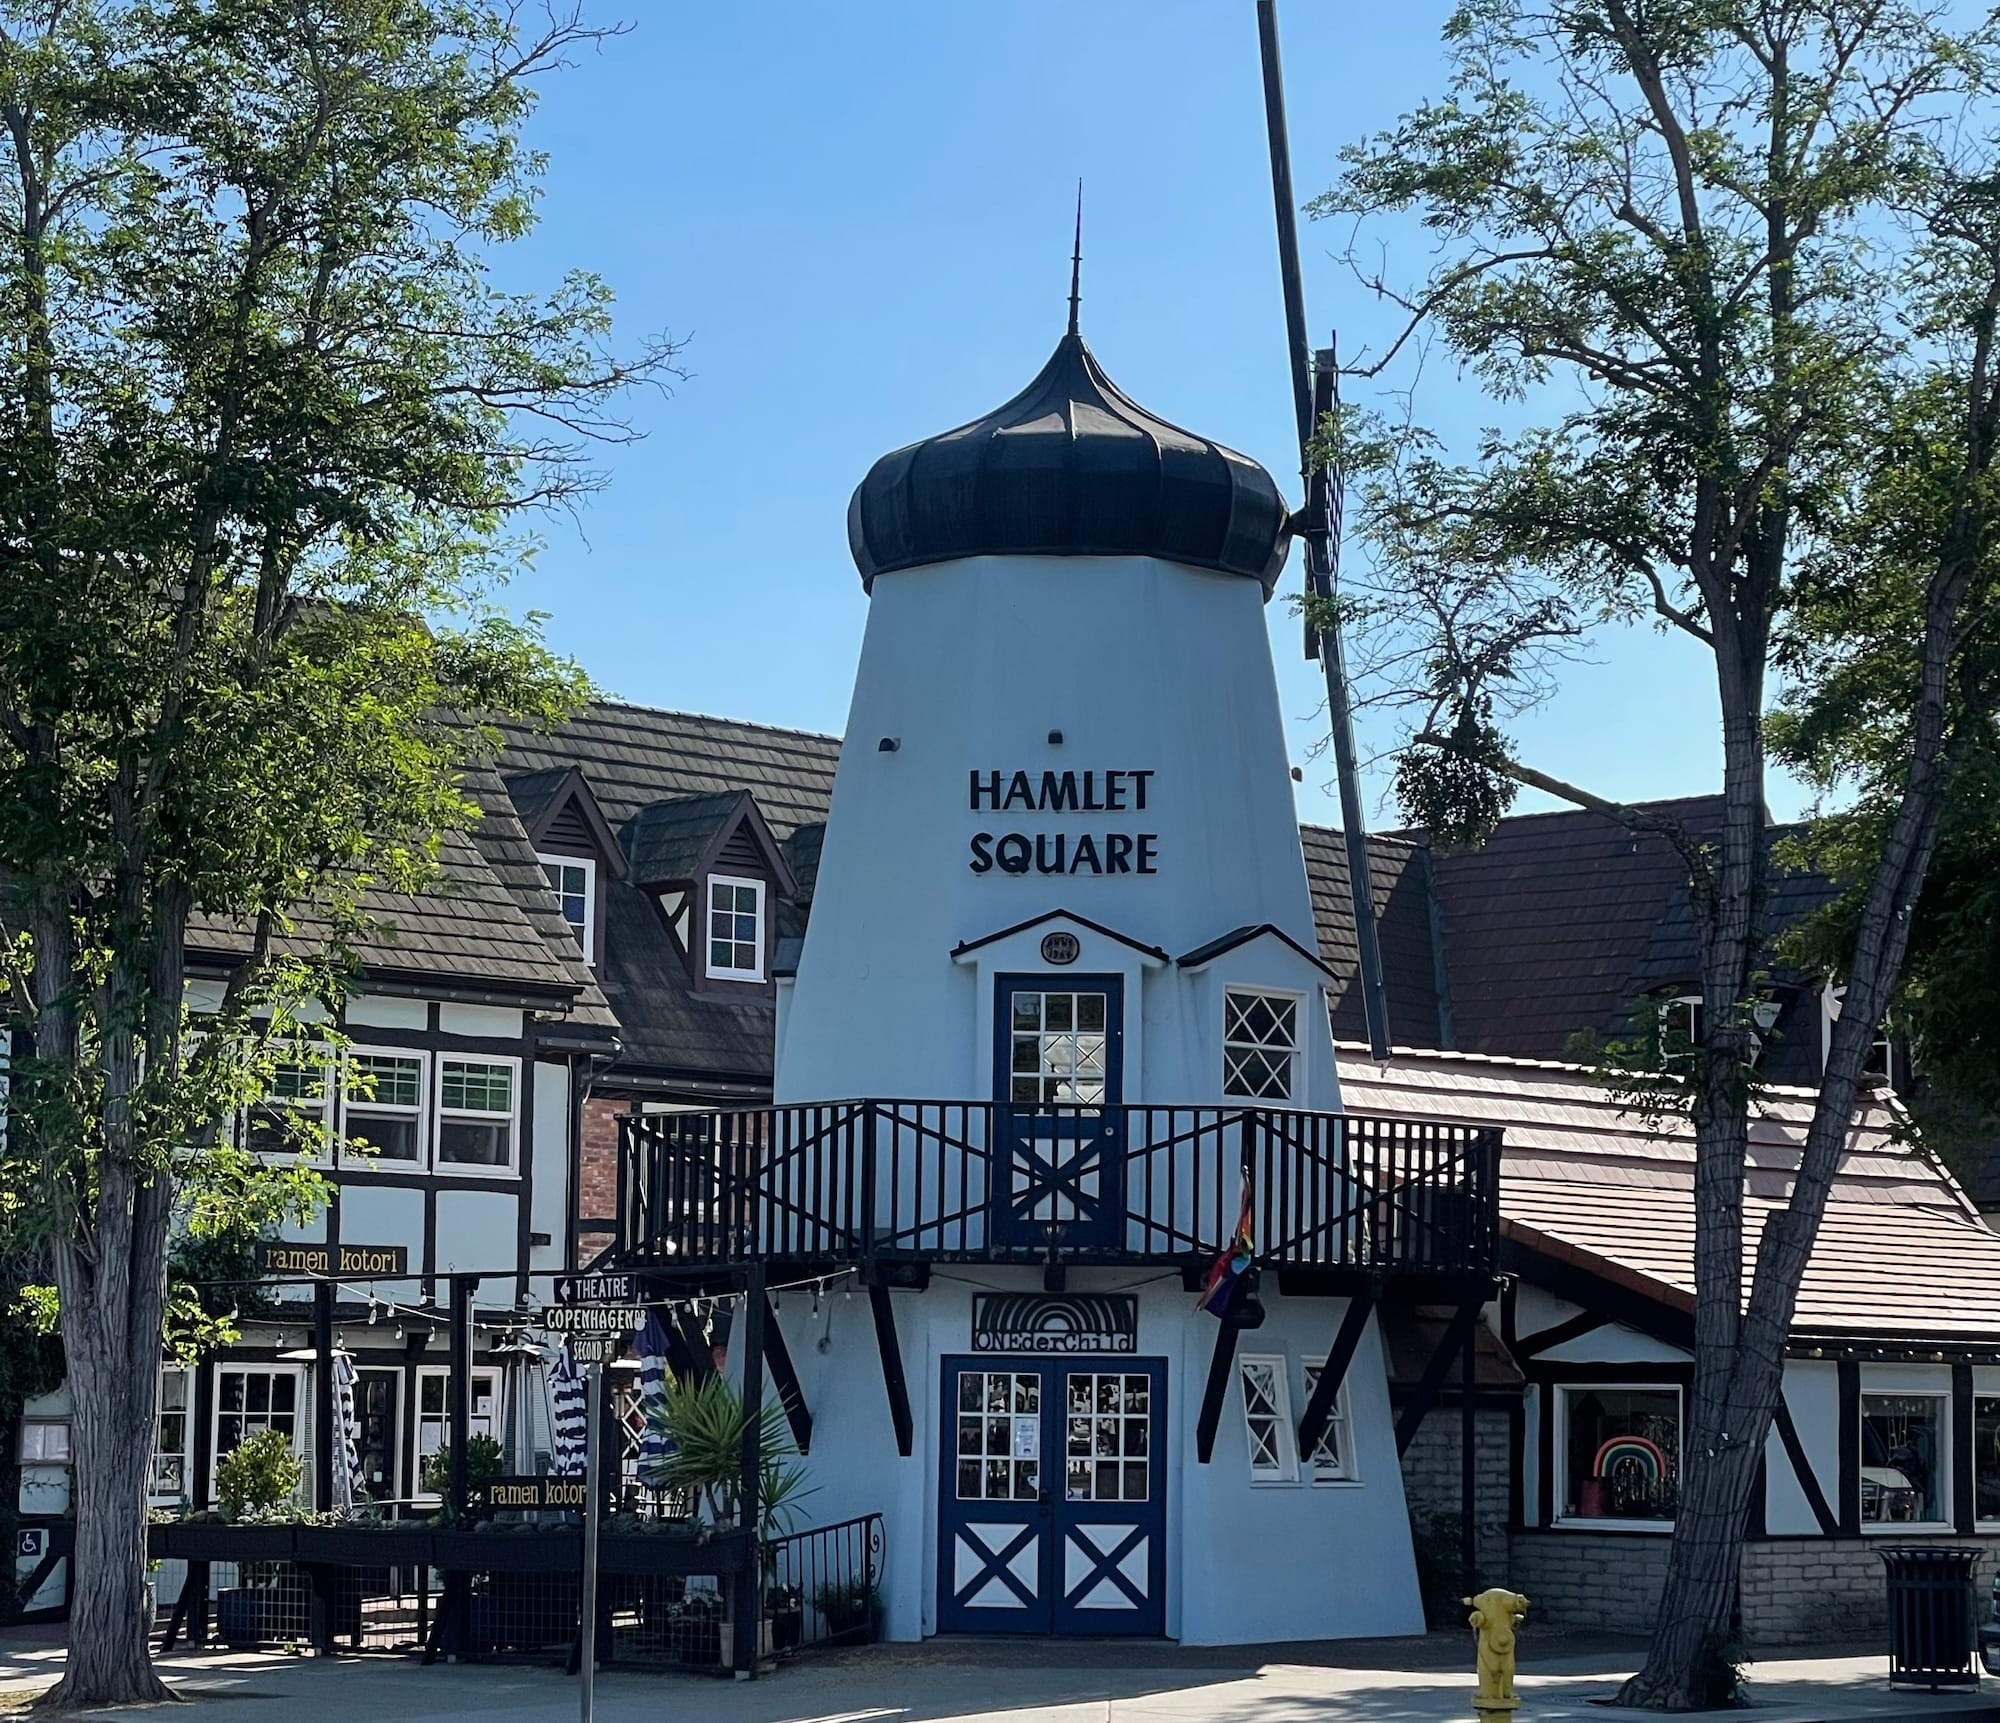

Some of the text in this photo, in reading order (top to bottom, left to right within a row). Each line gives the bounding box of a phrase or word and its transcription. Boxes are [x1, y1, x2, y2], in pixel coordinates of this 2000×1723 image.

[970, 770, 1155, 810] HAMLET
[969, 833, 1158, 874] SQUARE
[265, 1248, 397, 1272] ramen kotori
[575, 1277, 628, 1300] THEATRE
[546, 1309, 633, 1330] COPENHAGEN
[573, 1341, 613, 1360] SECOND ST
[976, 1332, 1131, 1351] ONEderChild
[490, 1480, 588, 1504] ramen kotor
